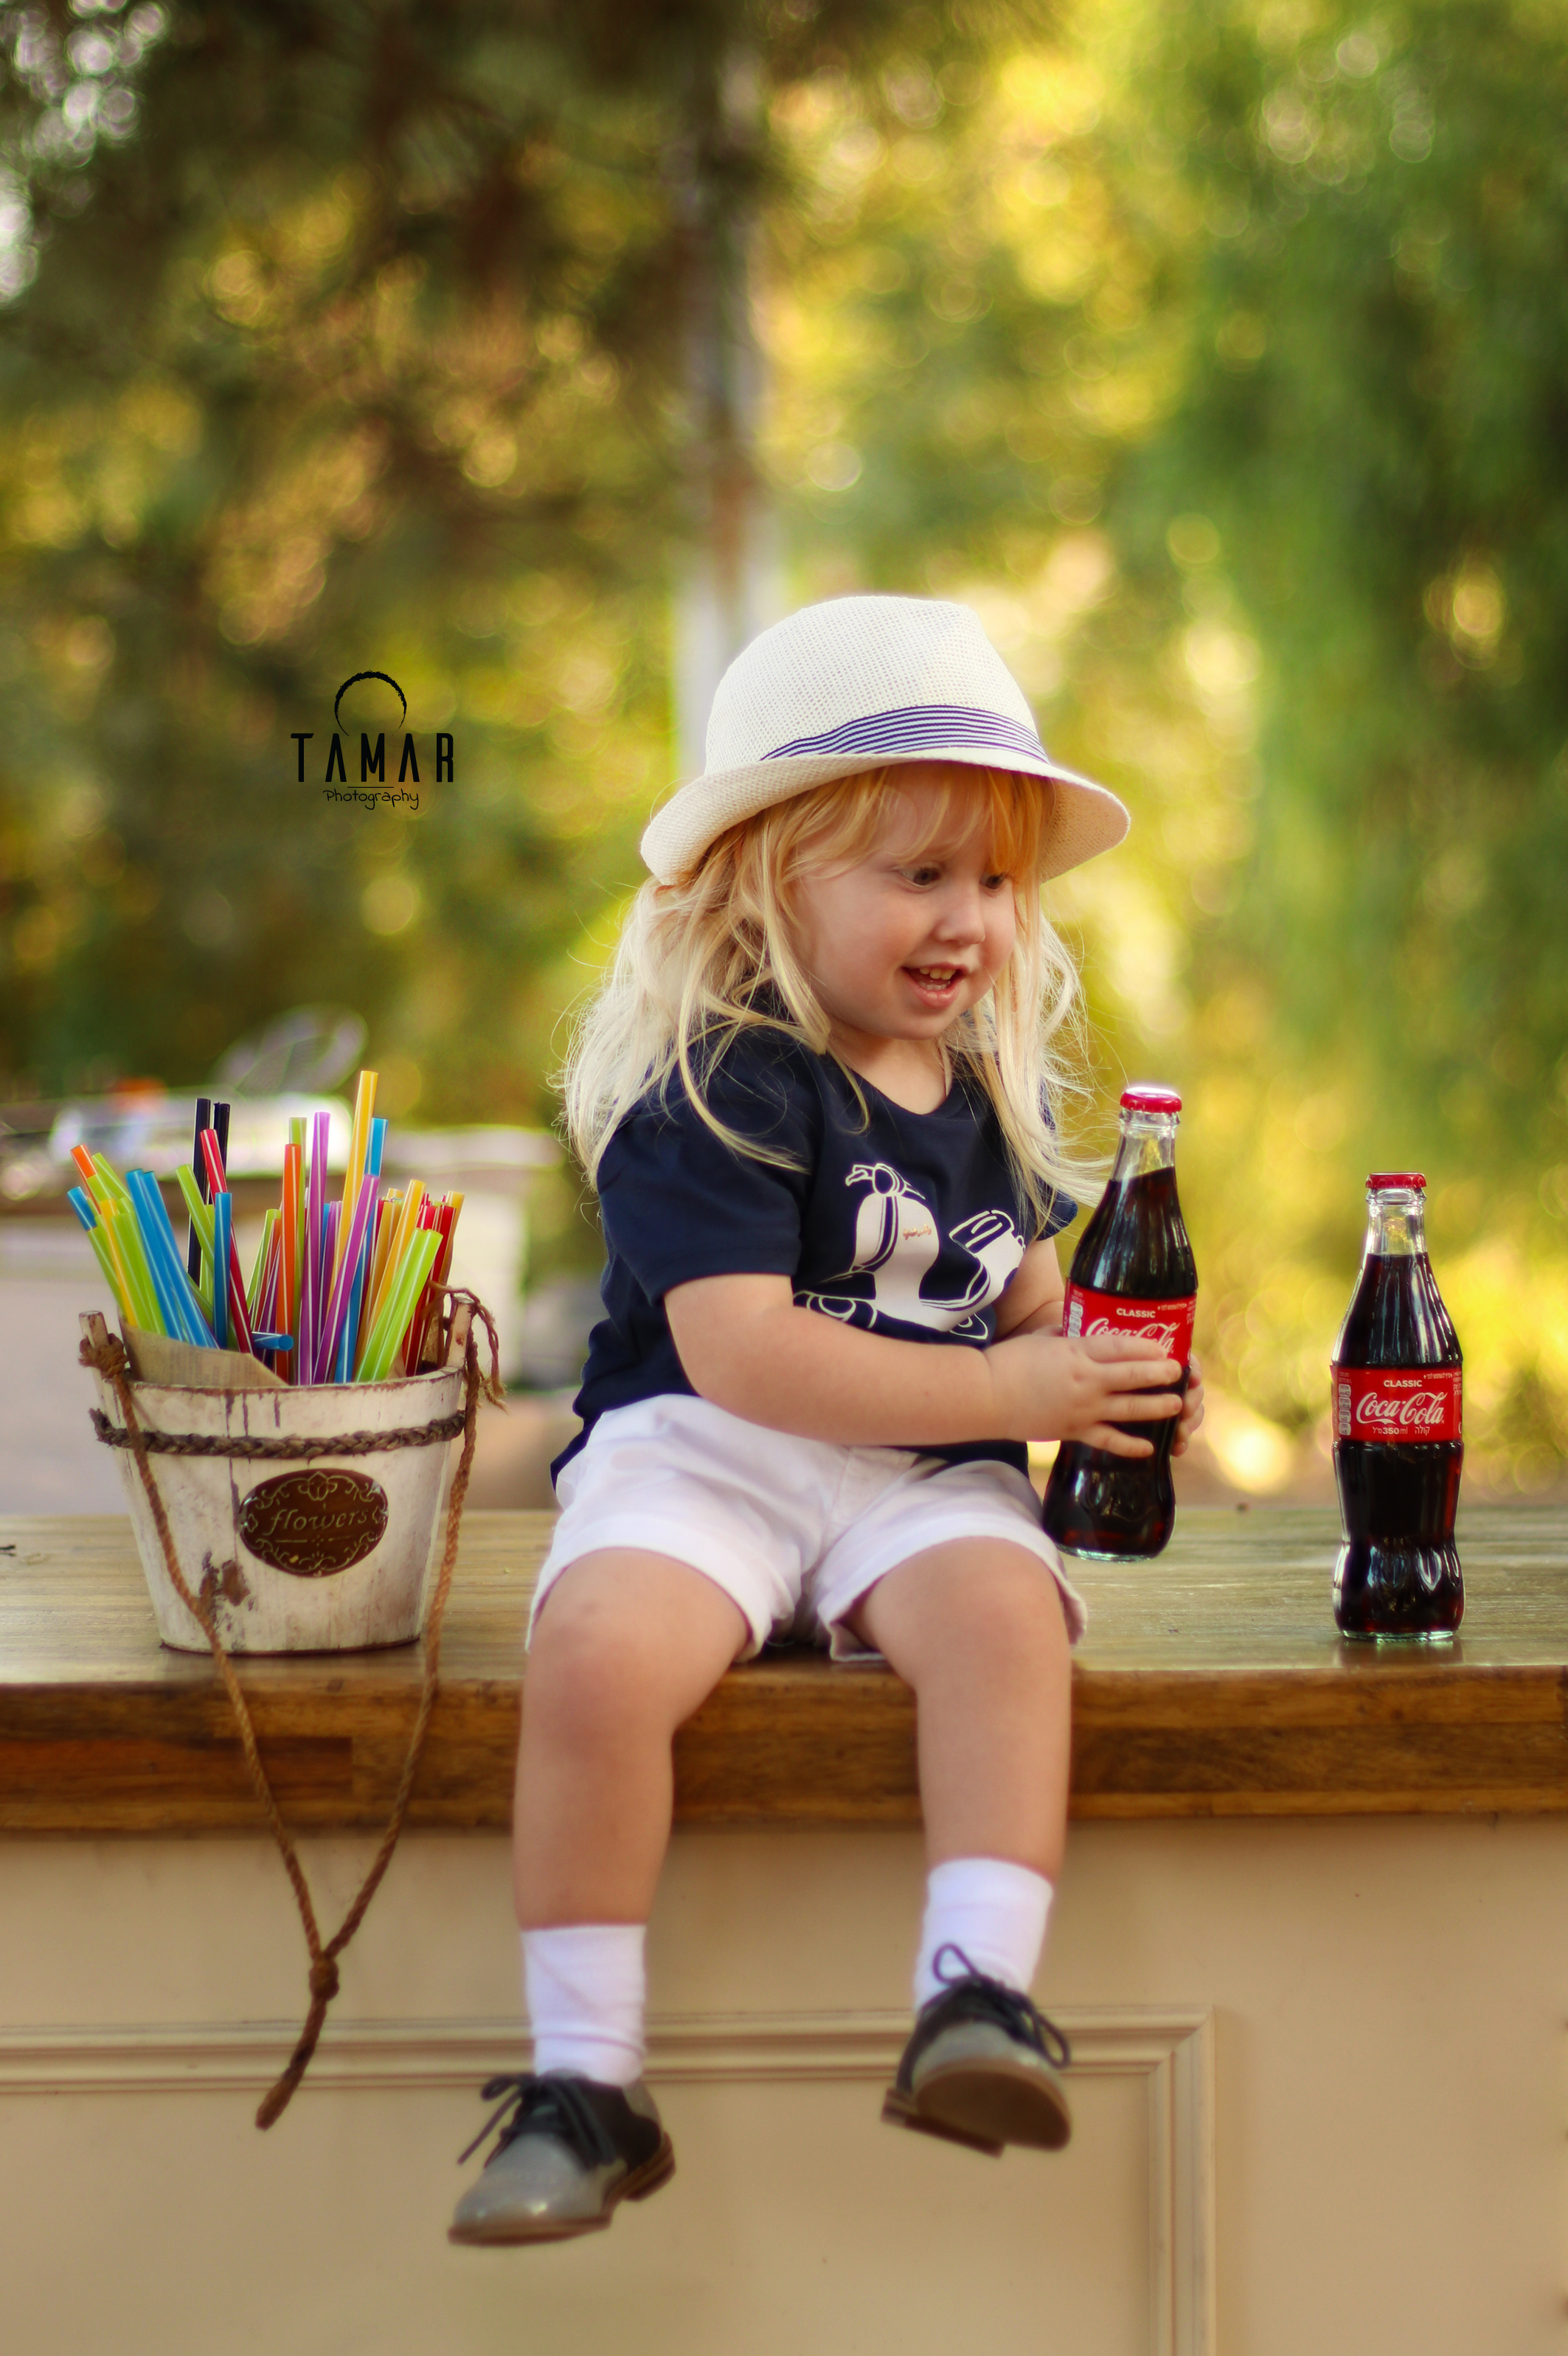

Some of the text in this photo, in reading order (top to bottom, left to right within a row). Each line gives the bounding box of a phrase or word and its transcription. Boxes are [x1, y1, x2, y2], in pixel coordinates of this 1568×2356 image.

[1116, 1307, 1156, 1319] CLASSIC
[1383, 1379, 1423, 1388] CLASSIC
[1356, 1391, 1449, 1425] Coca-Cola
[1414, 1424, 1431, 1437] קולה
[262, 1508, 369, 1536] flowers
